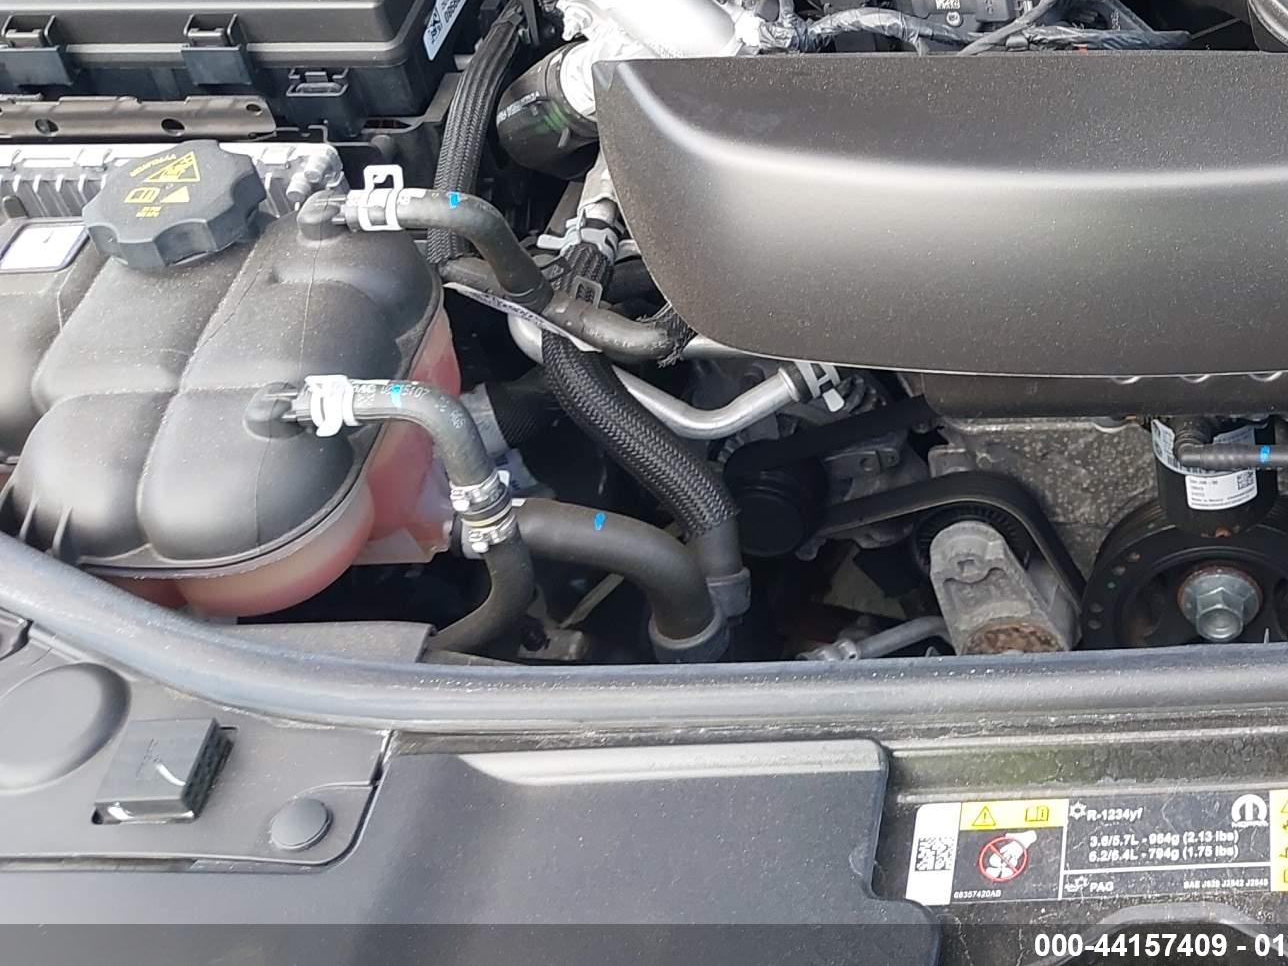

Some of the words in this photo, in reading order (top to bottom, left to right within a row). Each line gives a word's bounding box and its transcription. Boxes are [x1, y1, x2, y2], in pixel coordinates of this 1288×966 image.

[1087, 807, 1143, 822] R-1234yf
[1089, 835, 1139, 848] 3.6/5.7L
[1183, 831, 1212, 845] (2.13
[1216, 830, 1239, 843] lbs)
[1088, 849, 1138, 862] 6.2/6.4L
[1183, 846, 1212, 860] (1.75
[1216, 845, 1239, 858] lbs)
[1089, 881, 1114, 892] PAG
